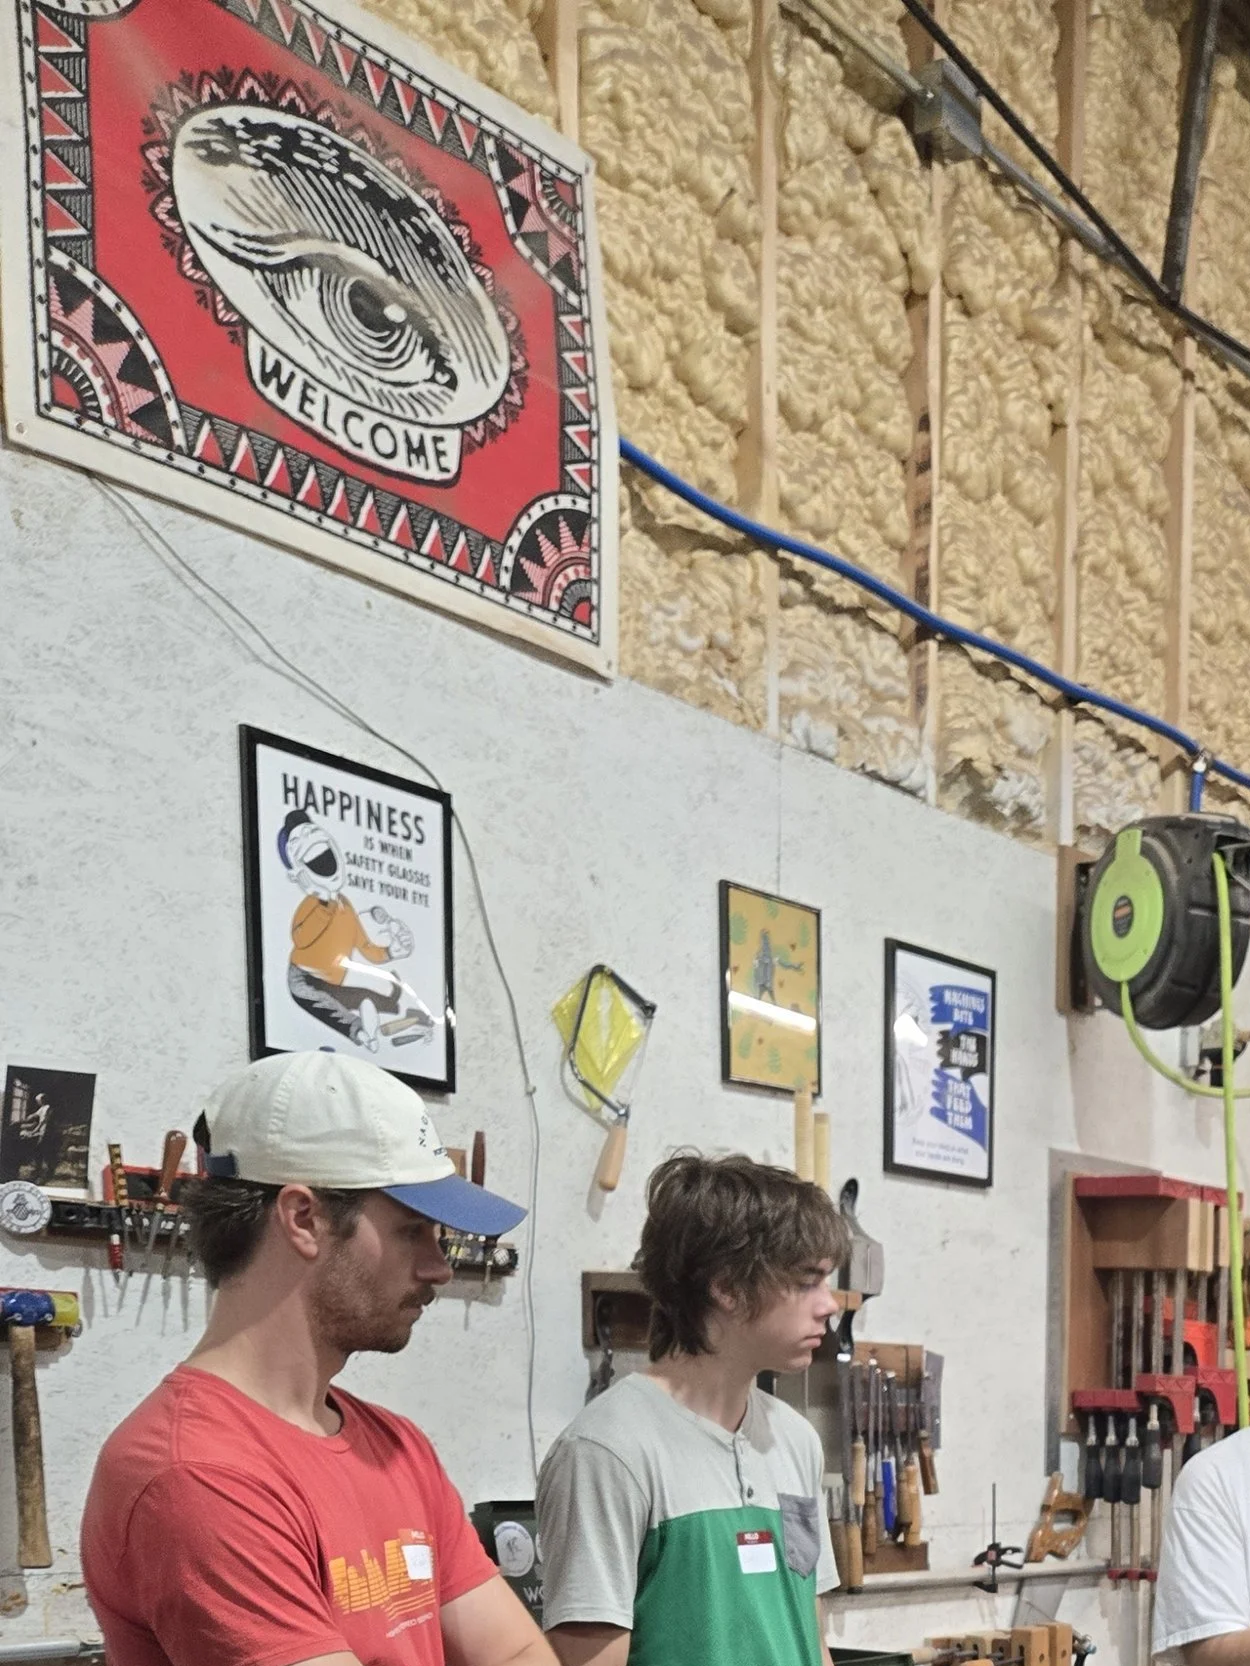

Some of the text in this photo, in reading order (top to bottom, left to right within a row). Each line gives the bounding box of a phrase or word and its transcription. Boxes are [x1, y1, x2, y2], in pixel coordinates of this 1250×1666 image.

[259, 345, 451, 474] WELCOME
[282, 773, 425, 845] HAPPINESS
[363, 835, 412, 862] IS WHEN
[345, 851, 431, 888] SAFETY GLASSES
[347, 873, 374, 893] SAVE
